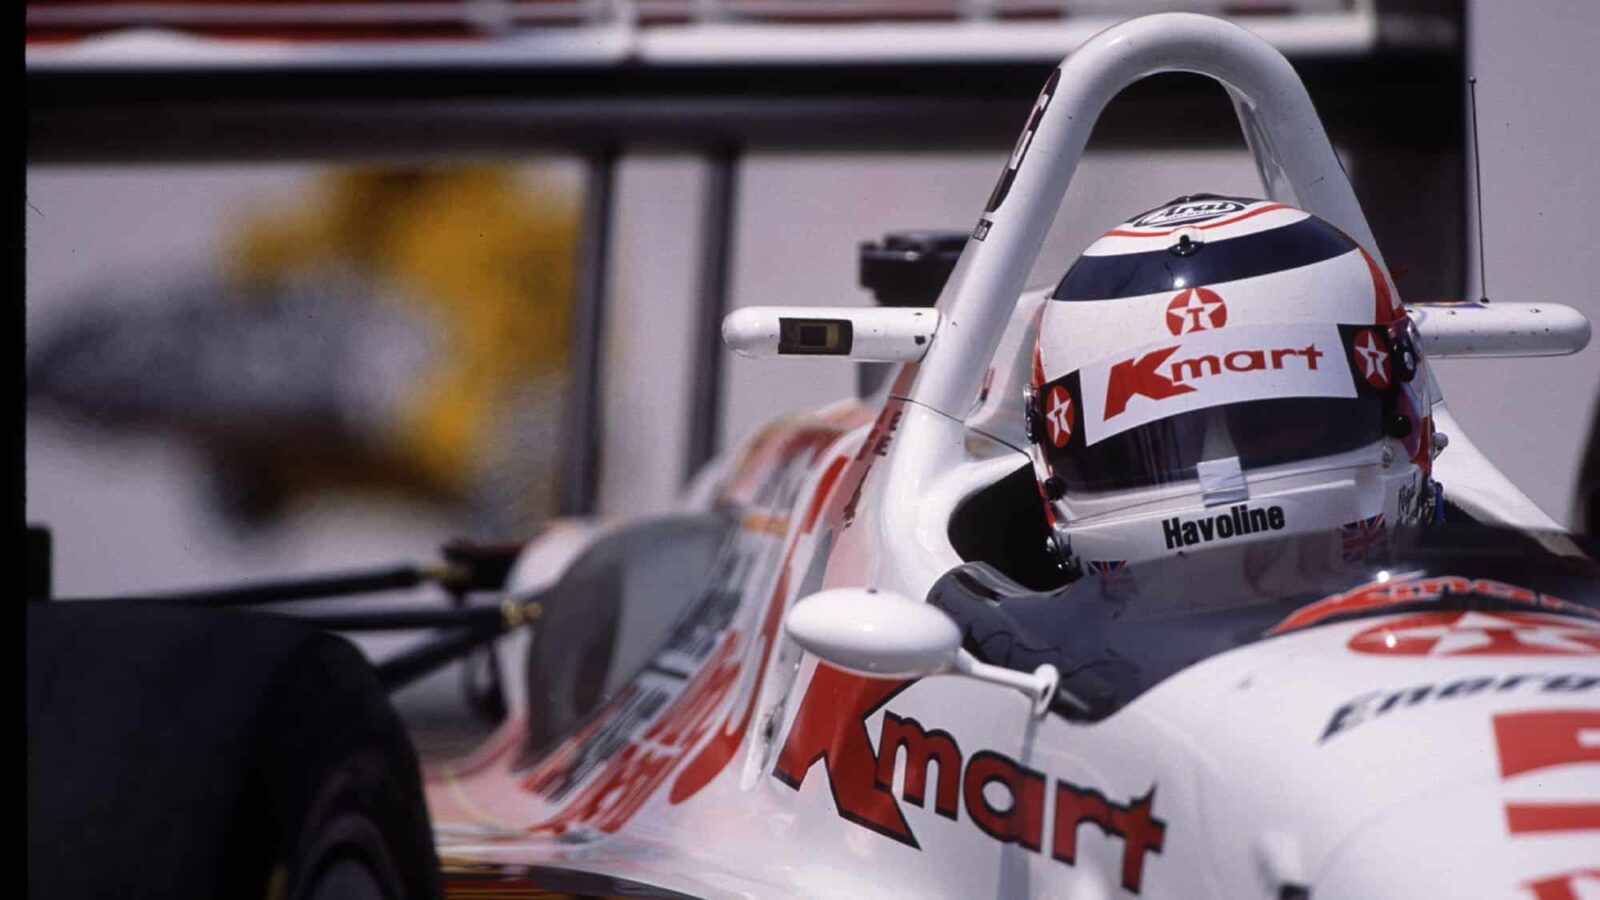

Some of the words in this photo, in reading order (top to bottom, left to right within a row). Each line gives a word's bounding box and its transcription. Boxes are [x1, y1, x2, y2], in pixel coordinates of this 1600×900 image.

[1103, 344, 1323, 422] Kmart
[1162, 503, 1286, 550] Havoline
[771, 661, 1168, 895] Kmart
